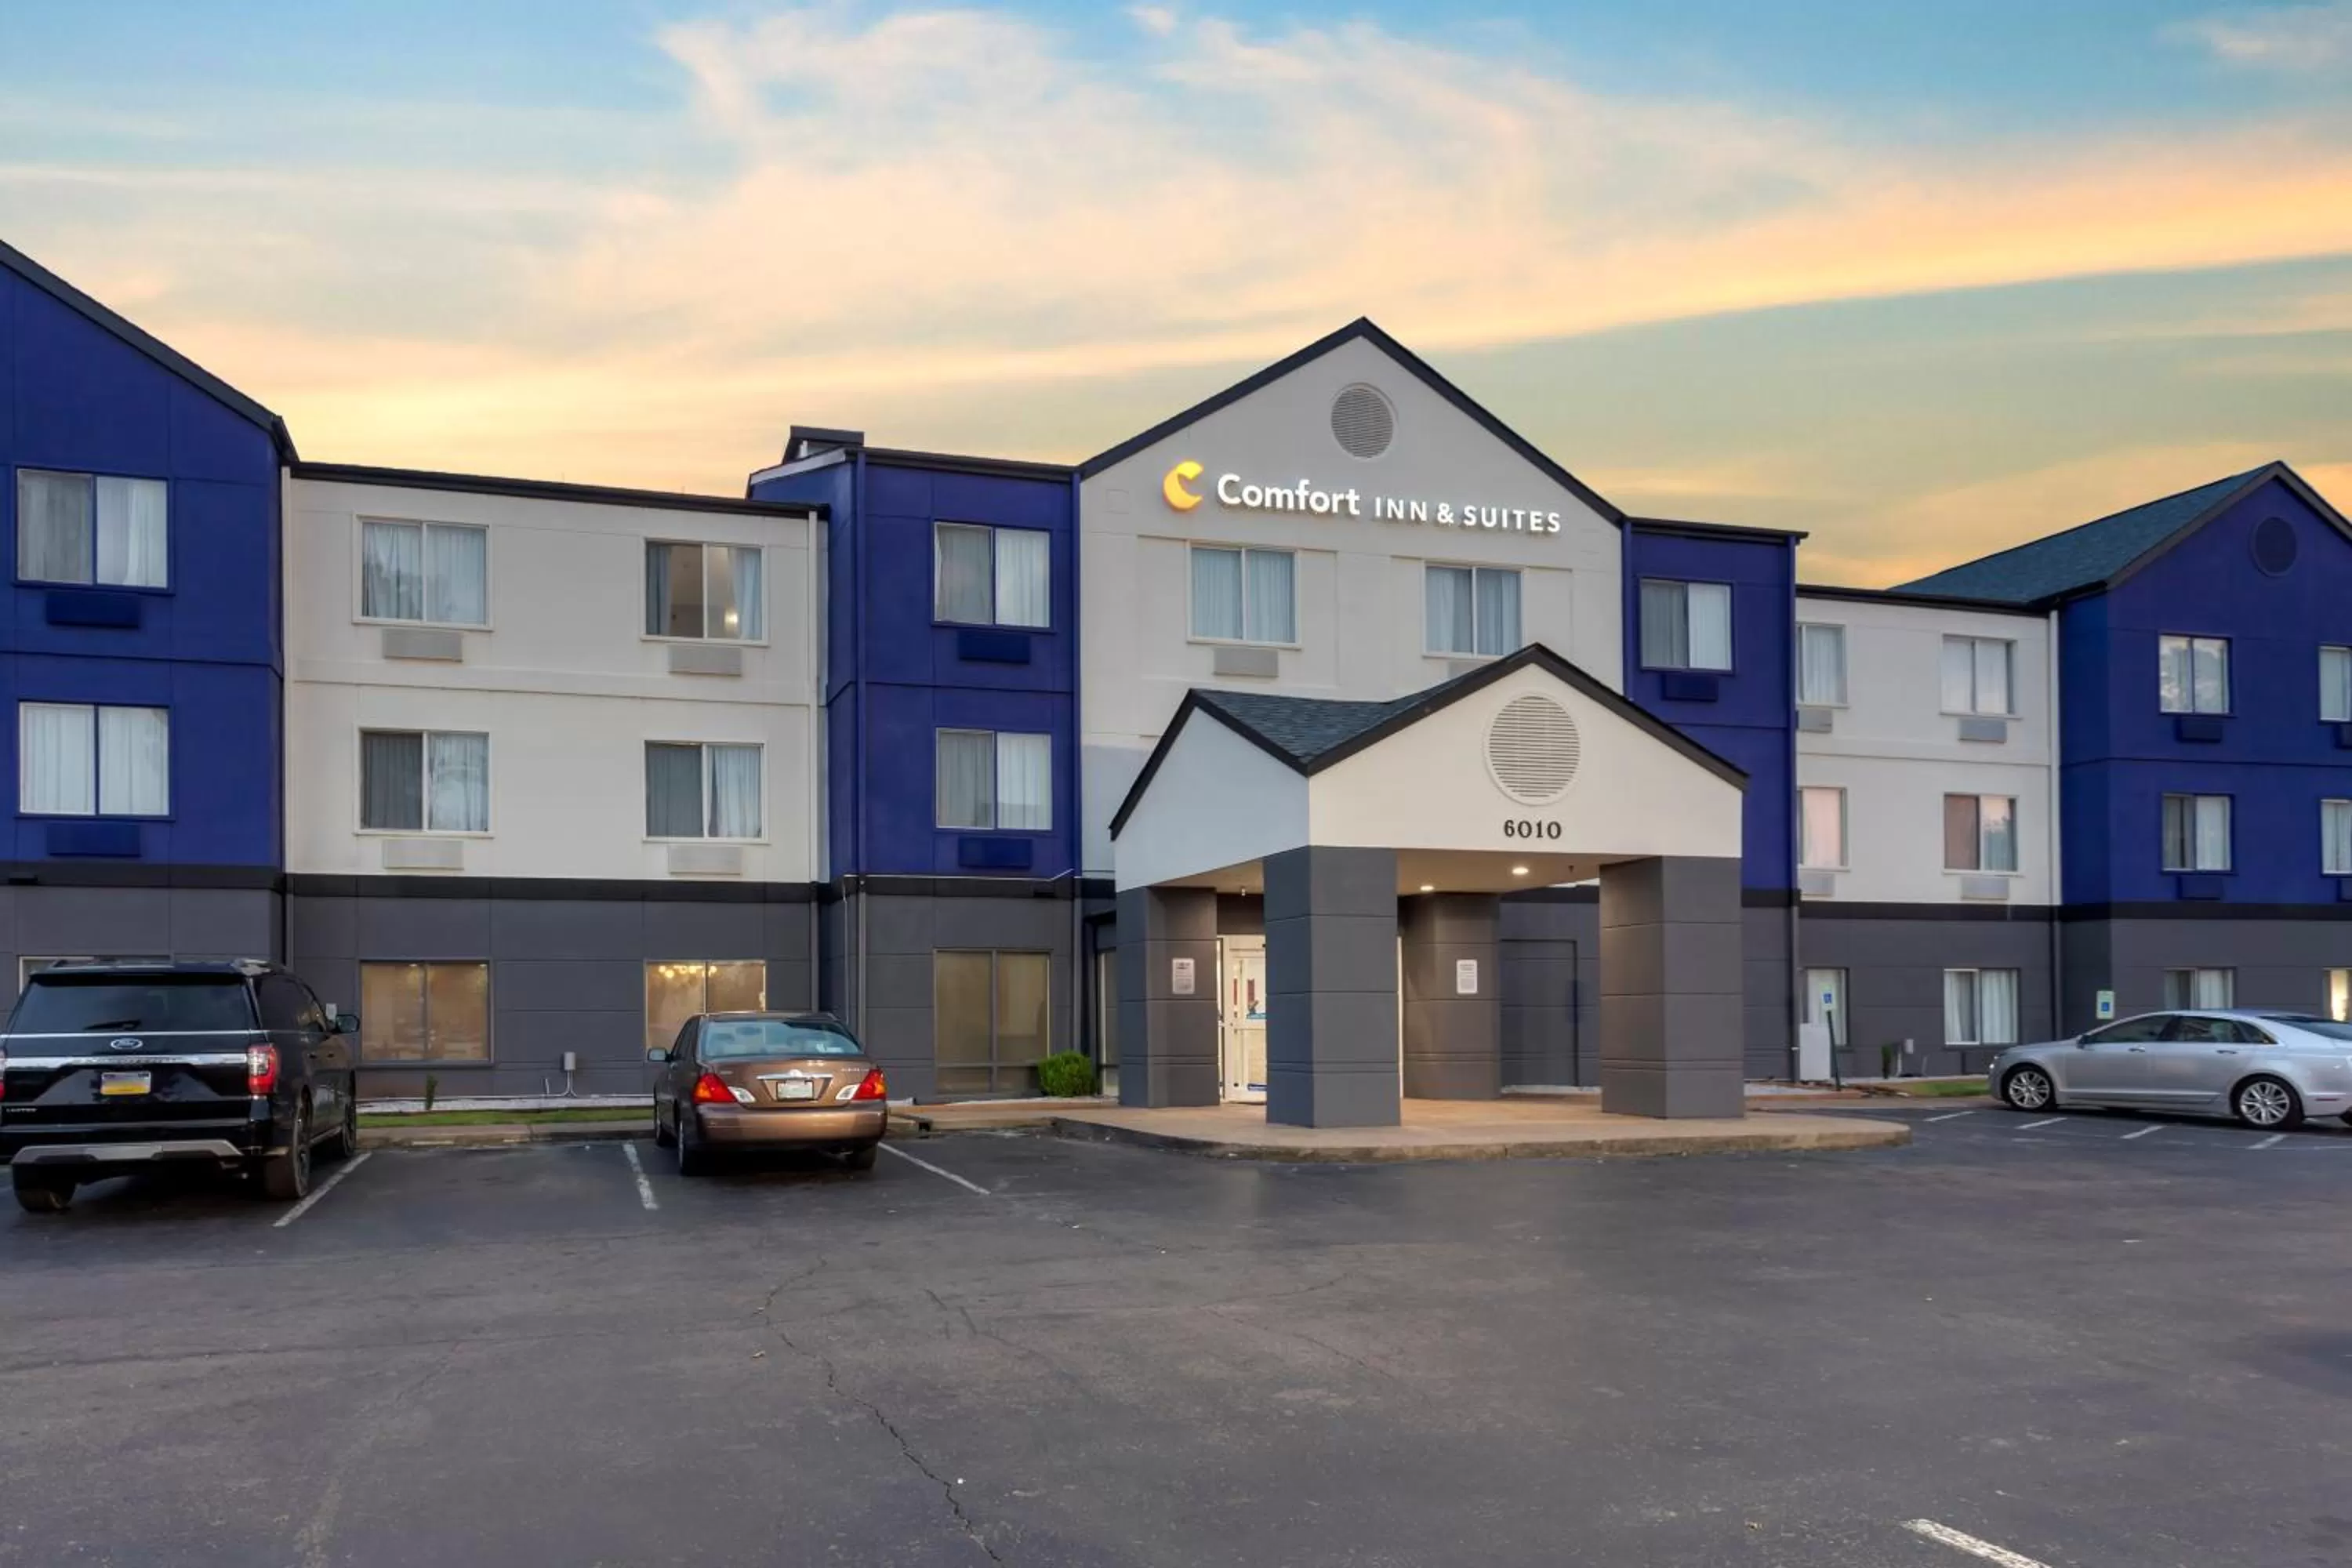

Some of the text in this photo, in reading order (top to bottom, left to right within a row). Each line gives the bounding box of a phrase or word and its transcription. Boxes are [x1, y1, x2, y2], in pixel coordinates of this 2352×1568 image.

[1217, 473, 1561, 533] Comfort INN & SUITES
[1504, 818, 1562, 840] 6010
